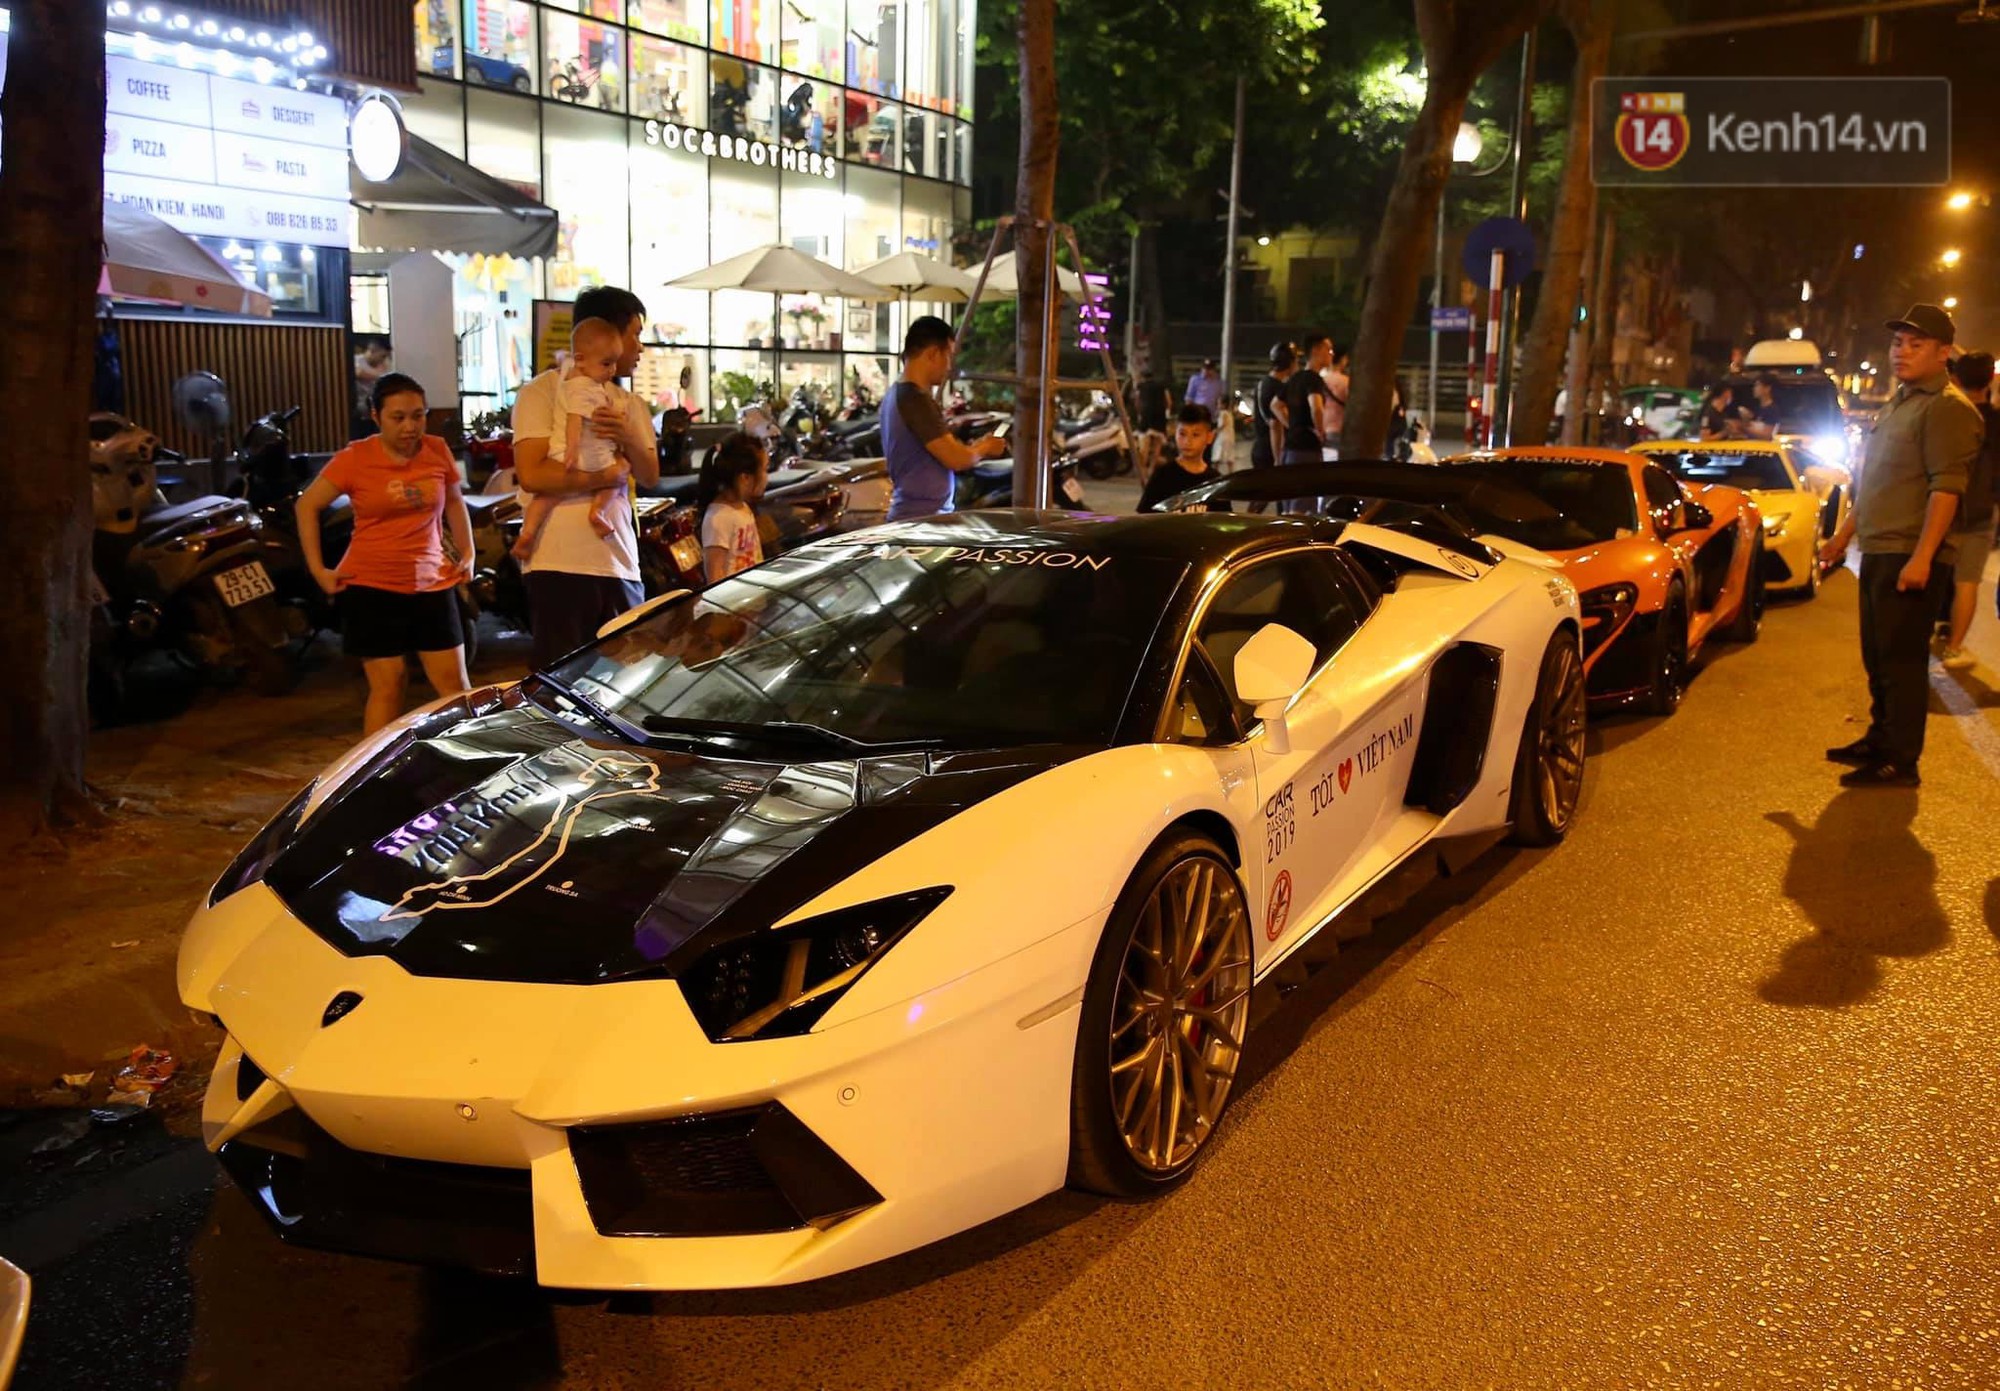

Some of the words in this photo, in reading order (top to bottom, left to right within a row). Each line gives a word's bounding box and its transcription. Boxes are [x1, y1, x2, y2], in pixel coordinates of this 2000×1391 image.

[127, 77, 171, 101] COFFEE
[272, 105, 315, 126] DESSERT
[132, 138, 167, 158] PIZZA
[644, 119, 837, 180] SOC&BROTHERS
[275, 159, 308, 178] PASTA
[933, 547, 1111, 571] PASSION
[1310, 772, 1334, 817] TÔI
[1356, 733, 1386, 778] VIỆT
[1388, 713, 1413, 756] NAM
[1266, 782, 1293, 818] CAR
[1266, 803, 1295, 837] PASSION
[1267, 820, 1295, 863] 2019
